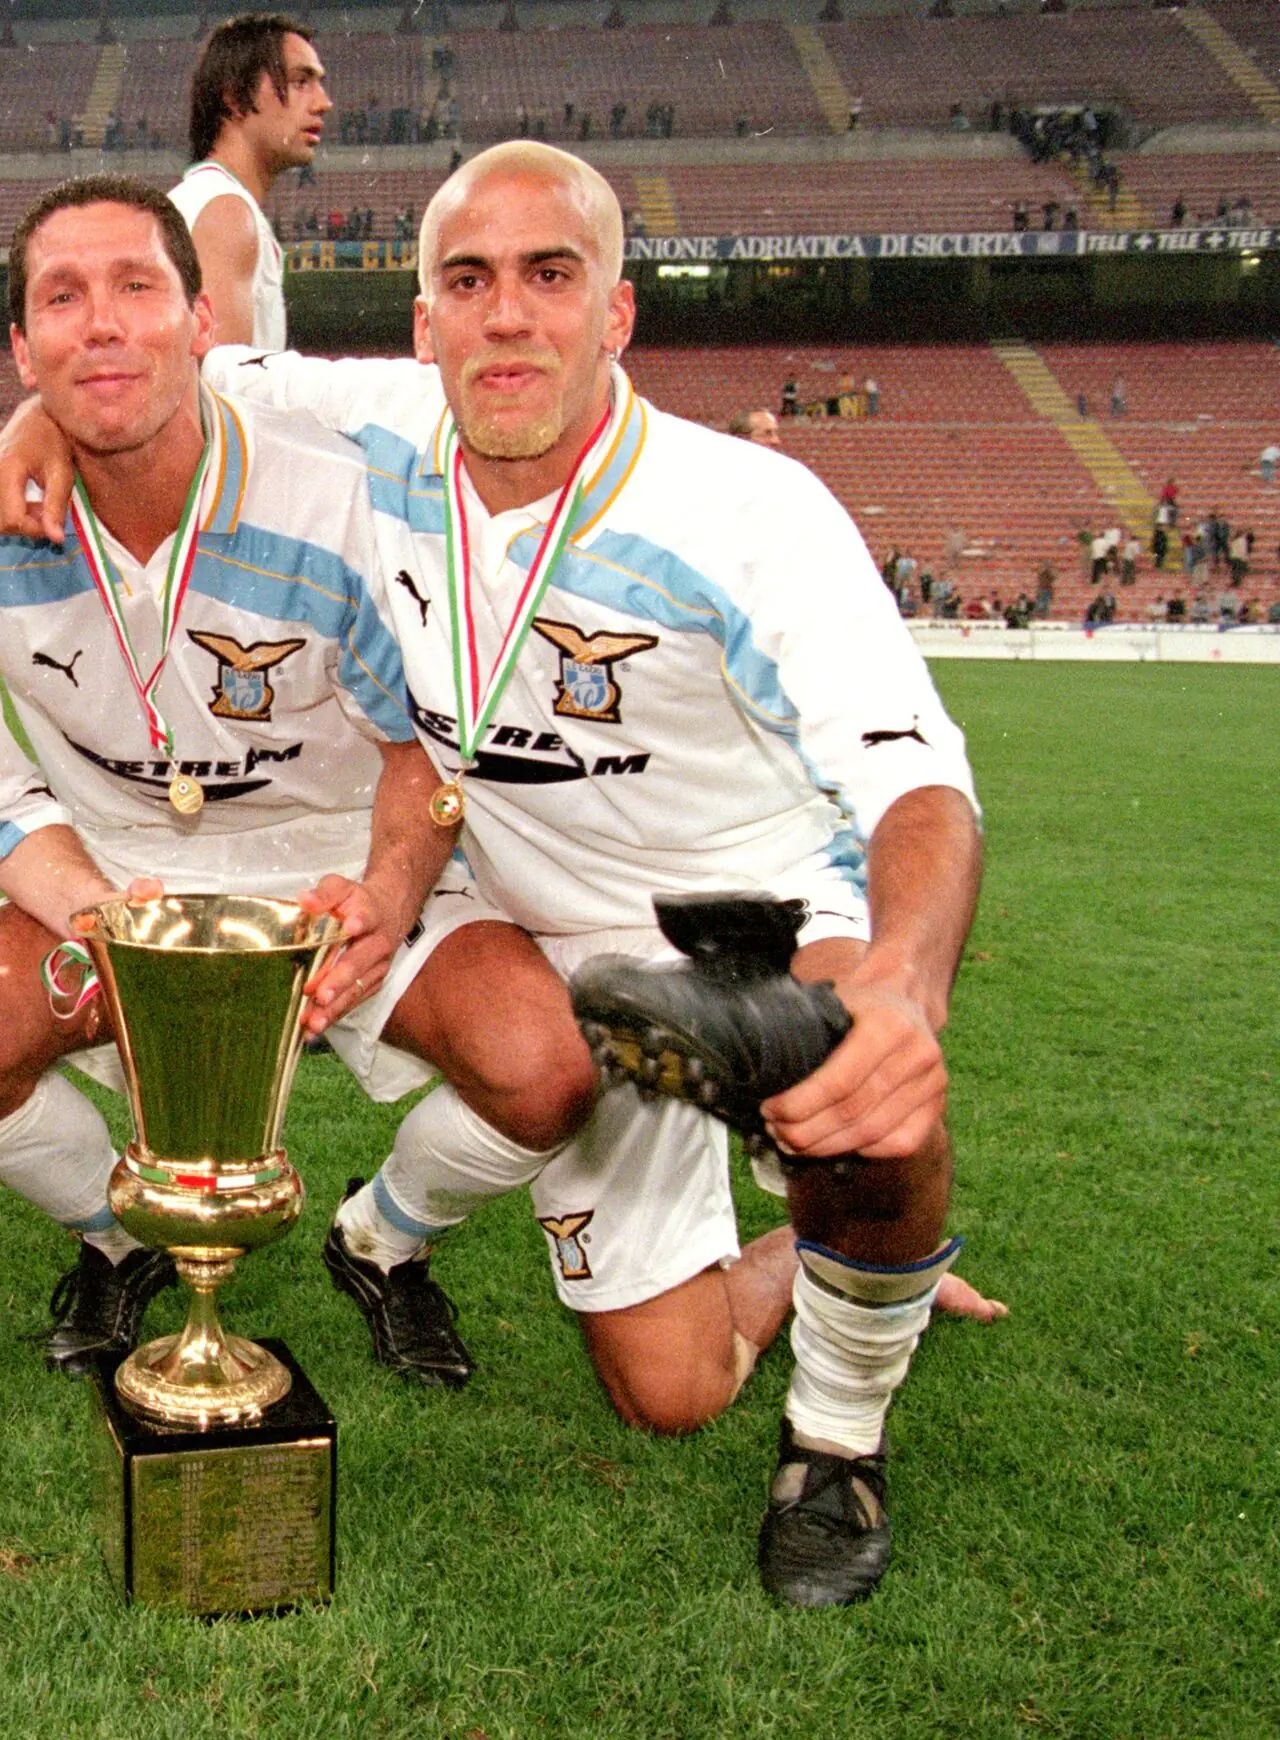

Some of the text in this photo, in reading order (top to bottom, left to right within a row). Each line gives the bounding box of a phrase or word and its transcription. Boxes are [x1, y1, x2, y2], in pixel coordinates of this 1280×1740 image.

[728, 234, 865, 258] ADRIATICA
[879, 233, 909, 256] DI
[1088, 234, 1128, 250] TELE
[1158, 233, 1200, 249] TELE
[1227, 231, 1271, 248] TELE
[422, 711, 652, 777] SREM
